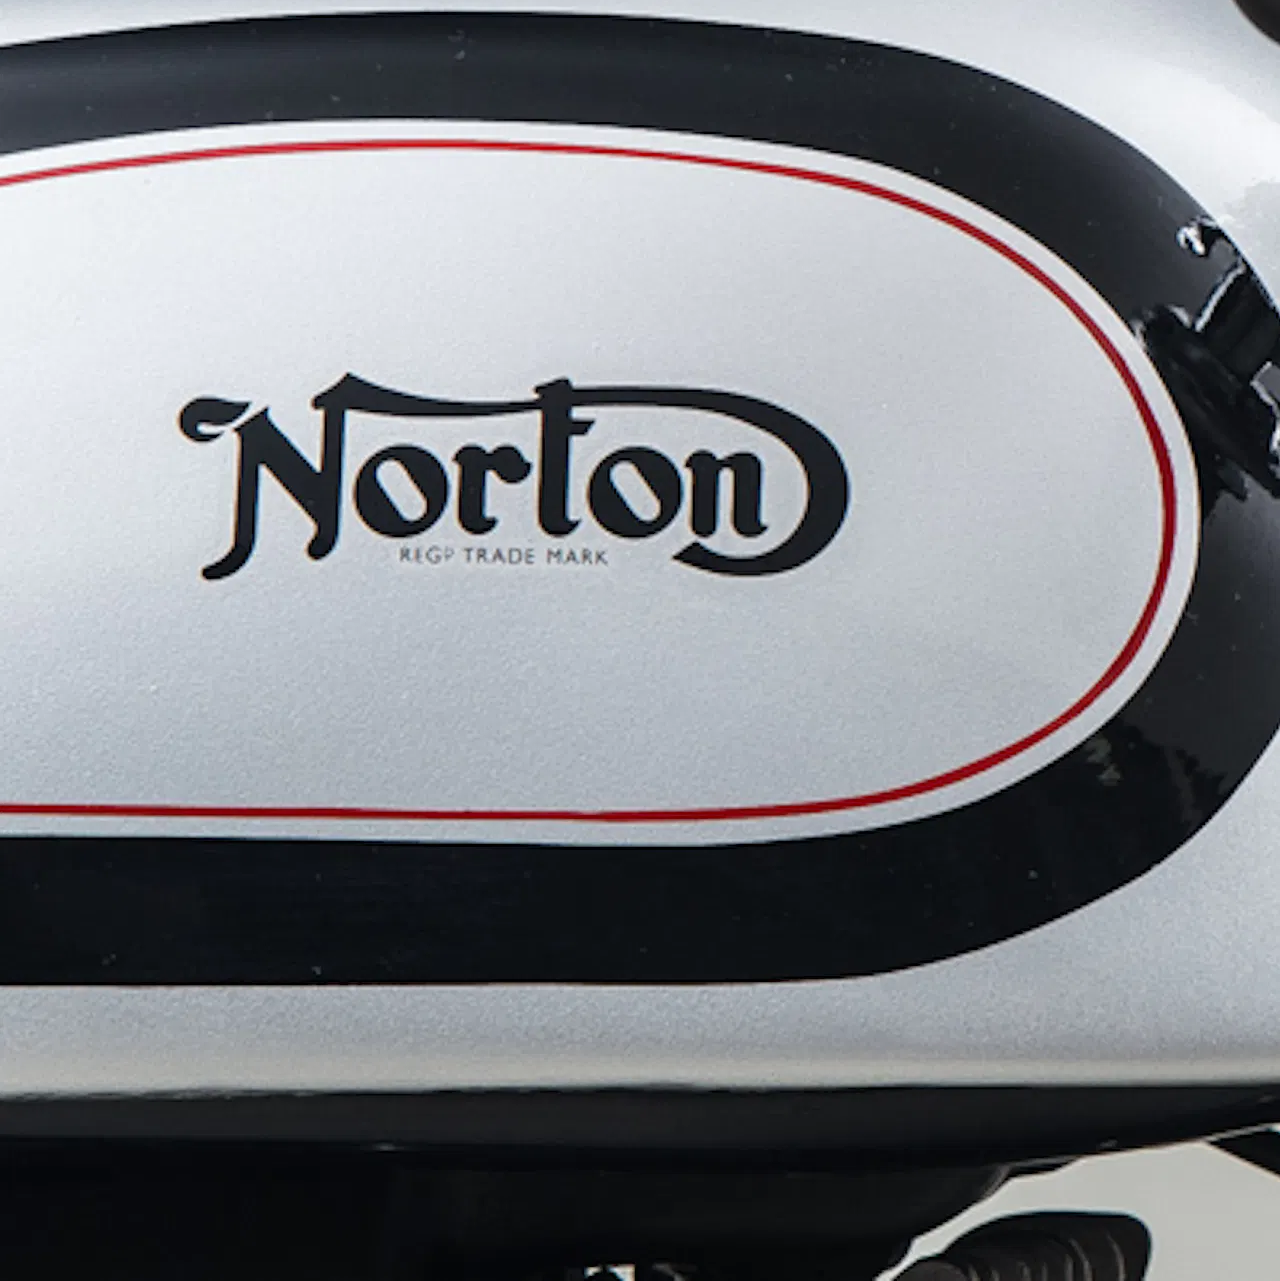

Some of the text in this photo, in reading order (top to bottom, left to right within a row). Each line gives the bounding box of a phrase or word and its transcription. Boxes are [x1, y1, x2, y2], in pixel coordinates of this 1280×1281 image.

[179, 372, 850, 581] Norton
[463, 547, 535, 565] TRADE
[547, 548, 608, 565] MARK
